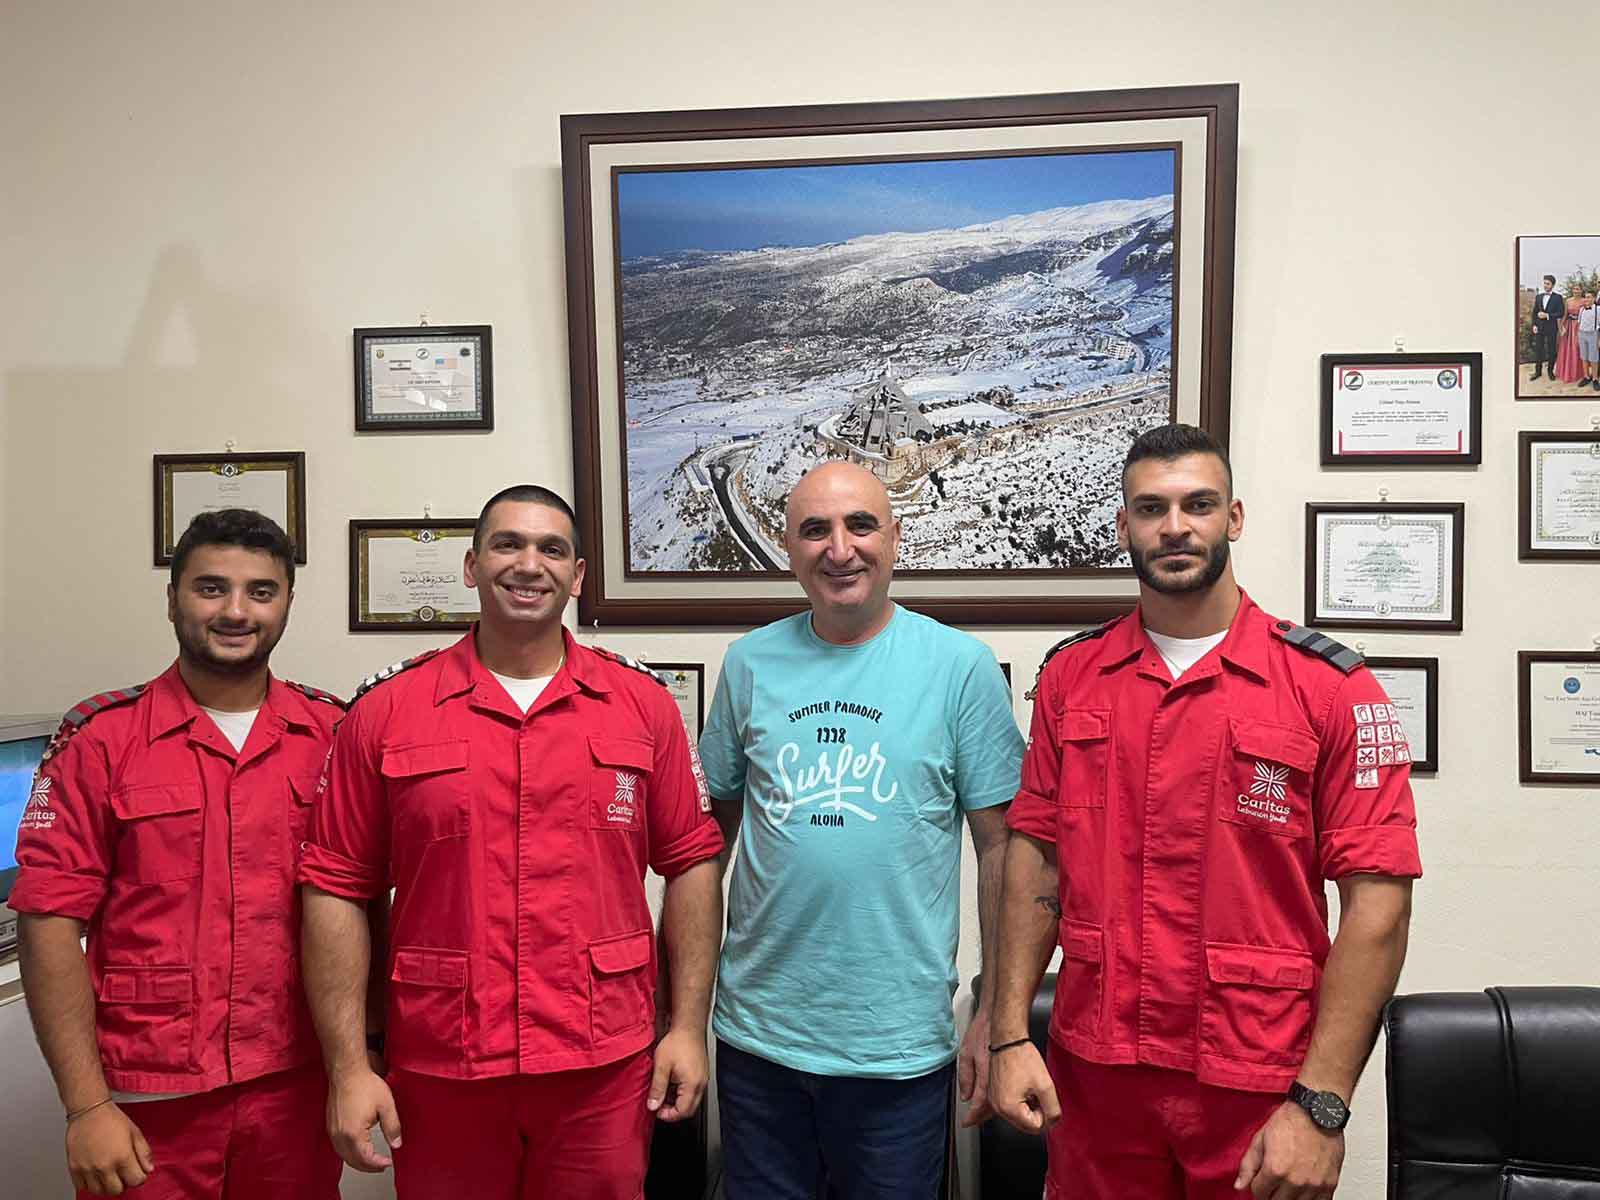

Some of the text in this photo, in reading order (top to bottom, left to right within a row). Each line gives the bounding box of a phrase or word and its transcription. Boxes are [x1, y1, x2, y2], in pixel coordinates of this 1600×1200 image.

[788, 700, 883, 724] SUMMER PARADISE
[764, 742, 898, 825] Surfer
[1238, 794, 1291, 815] Caritas
[810, 814, 844, 827] ALOHA
